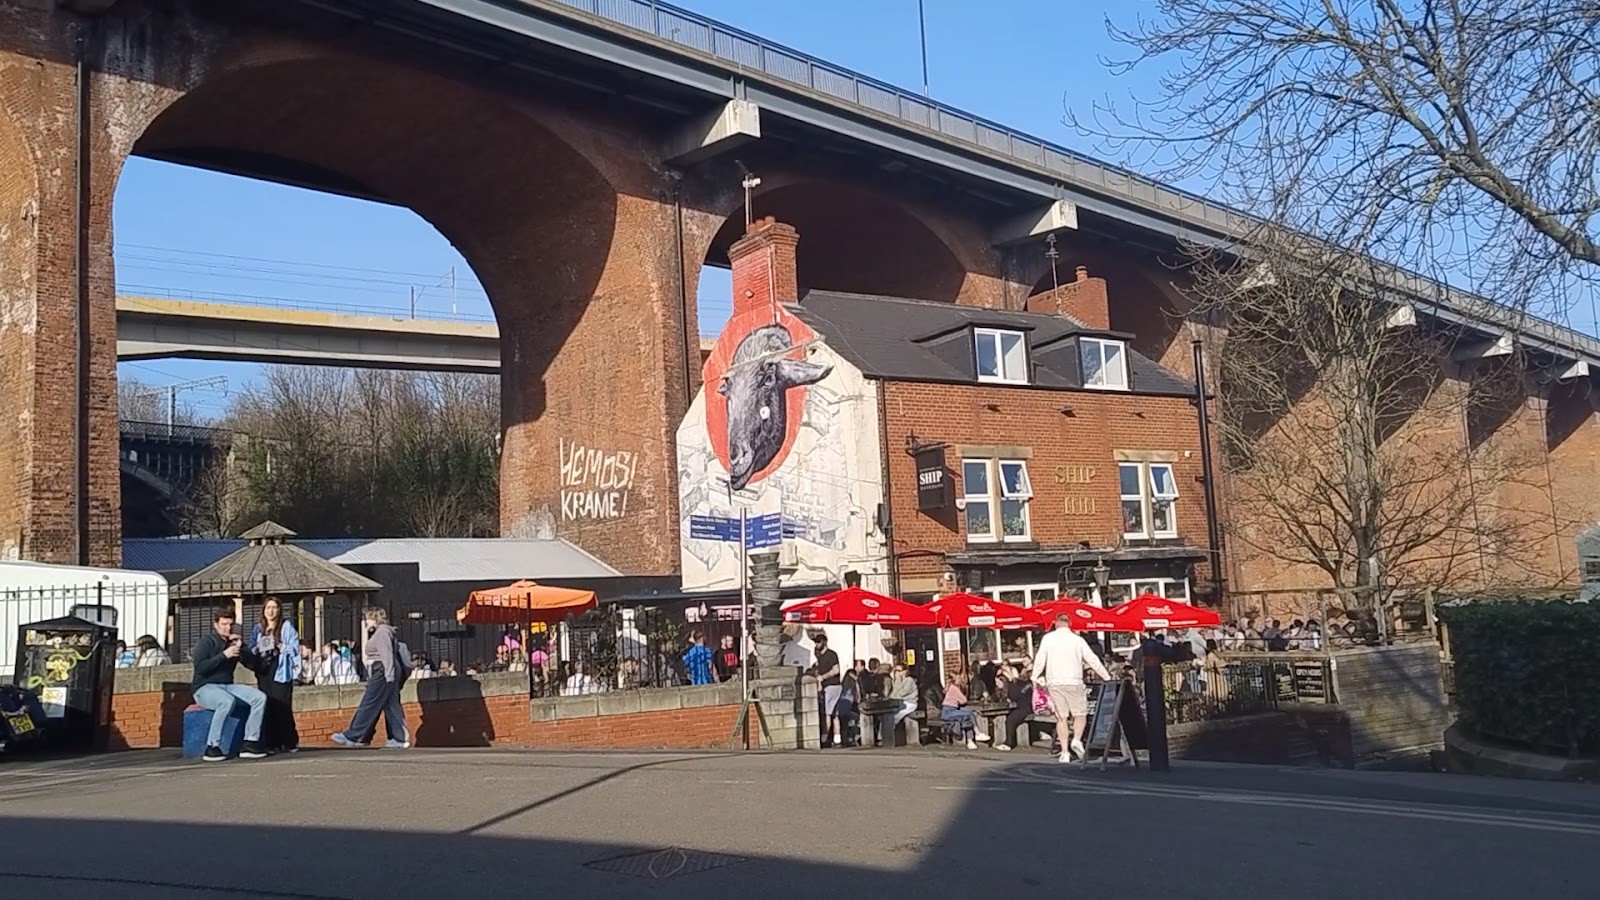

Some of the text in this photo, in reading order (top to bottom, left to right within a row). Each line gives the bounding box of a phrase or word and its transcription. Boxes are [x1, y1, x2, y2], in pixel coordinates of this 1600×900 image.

[919, 470, 943, 485] SHIP
[1055, 466, 1096, 484] SHIP
[560, 489, 627, 521] KRAME!
